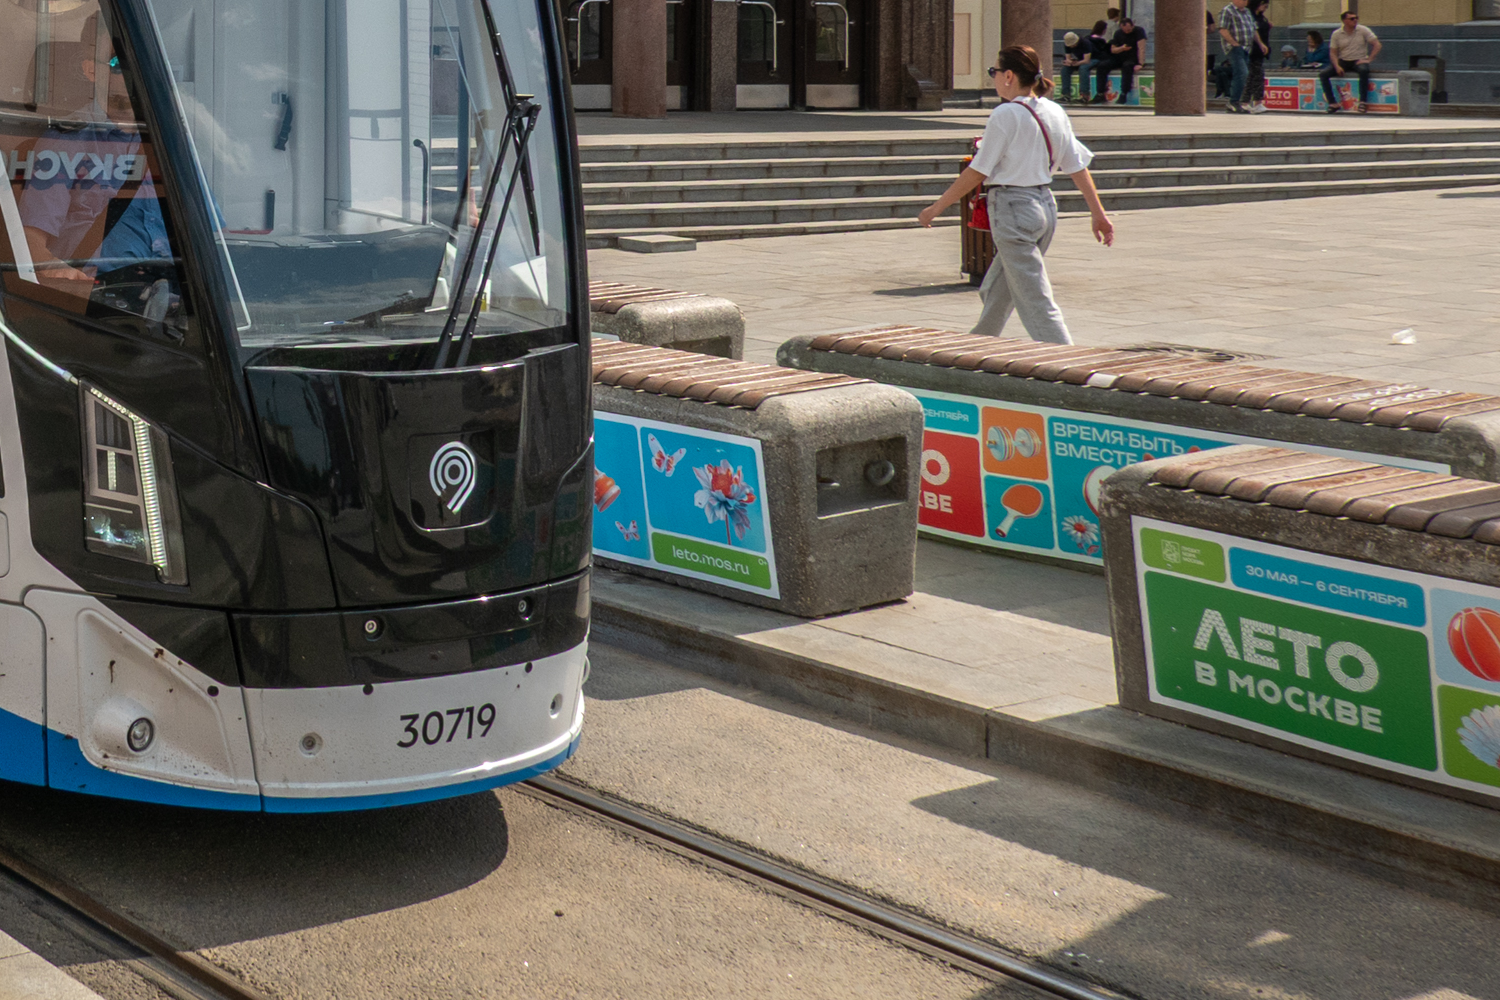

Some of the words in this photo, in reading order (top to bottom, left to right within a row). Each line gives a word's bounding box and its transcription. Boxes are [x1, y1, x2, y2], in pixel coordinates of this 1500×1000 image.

[1052, 422, 1125, 446] ВРЕМЯ
[1128, 432, 1184, 455] БЫТЬ
[1054, 441, 1138, 465] ВМЕСТЕ
[672, 545, 750, 575] leto.mos.ru
[1246, 564, 1265, 578] 30
[1266, 570, 1299, 586] МАЯ
[1315, 580, 1327, 592] 6
[1328, 583, 1409, 609] СЕНТЯБРЯ
[1193, 608, 1380, 693] ЛЕТО
[1194, 660, 1217, 687] В
[1228, 668, 1384, 734] МОСКВЕ
[397, 703, 496, 748] 30719
